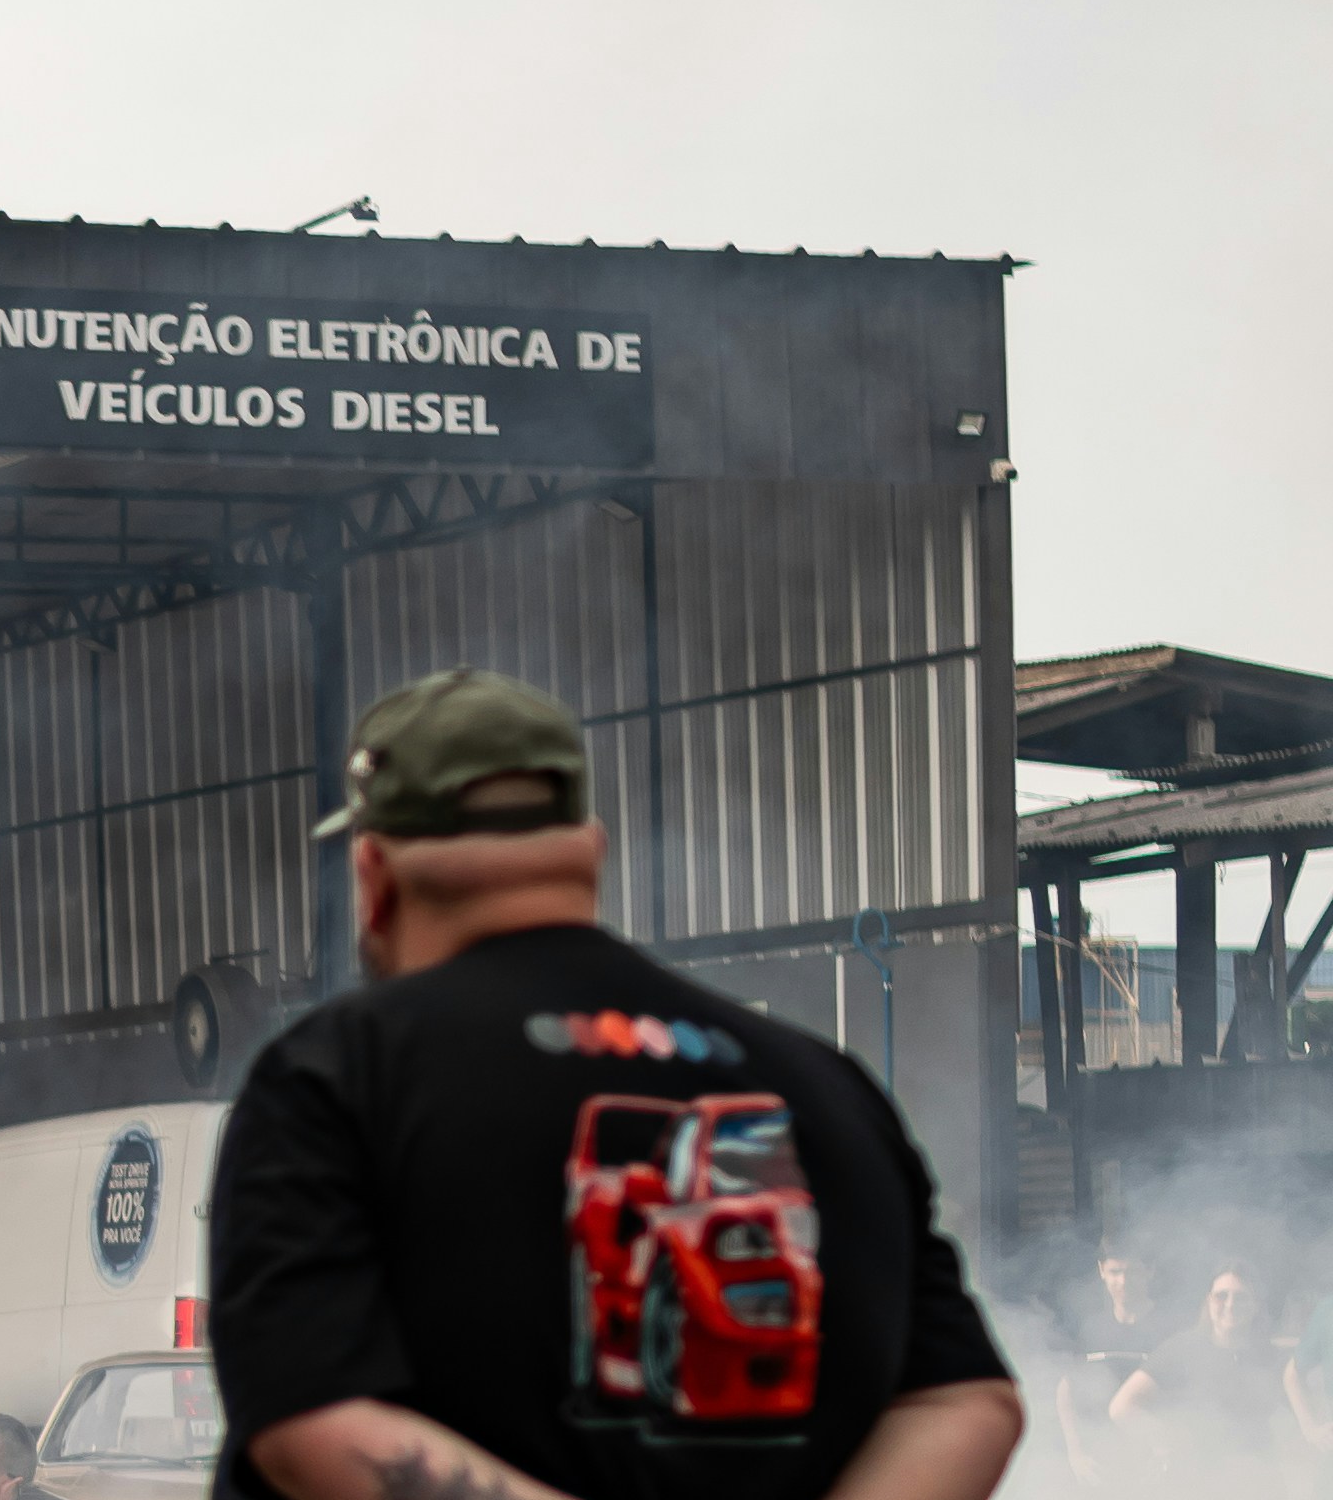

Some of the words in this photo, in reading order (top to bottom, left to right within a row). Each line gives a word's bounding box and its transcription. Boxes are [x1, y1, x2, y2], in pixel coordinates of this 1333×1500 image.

[267, 309, 559, 370] ELETRÔNICA
[577, 330, 643, 373] DE
[59, 370, 306, 429] VEÍCULOS
[331, 391, 500, 435] DIESEL
[111, 1164, 128, 1178] TEST
[106, 1191, 145, 1223] 100%
[102, 1228, 119, 1244] PRA
